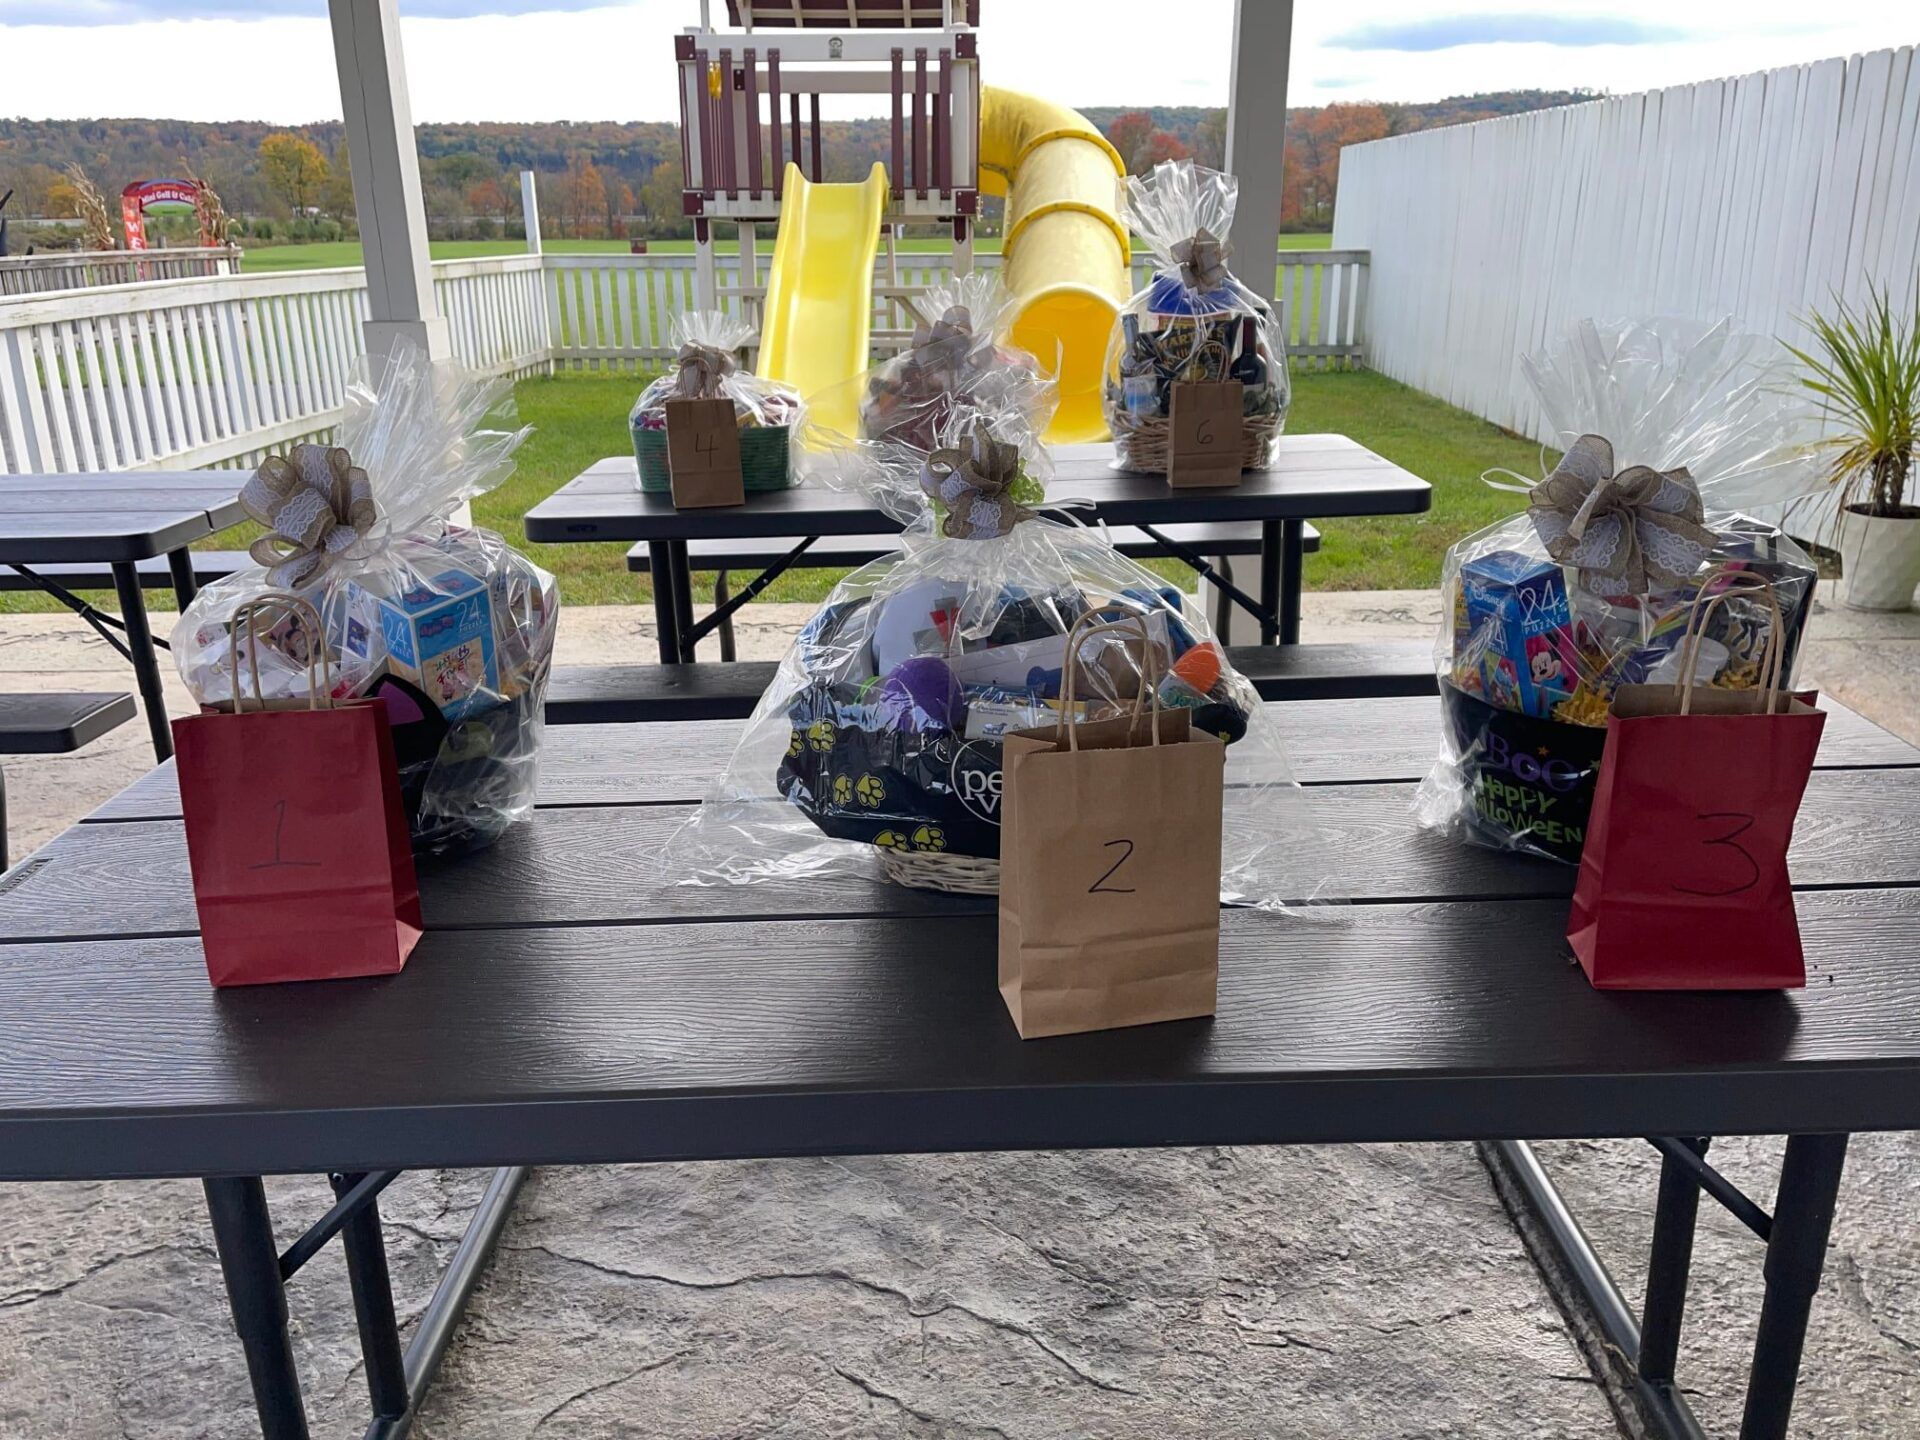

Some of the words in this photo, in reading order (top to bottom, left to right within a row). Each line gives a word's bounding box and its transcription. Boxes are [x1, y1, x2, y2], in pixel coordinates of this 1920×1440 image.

[695, 432, 719, 468] 4
[1196, 418, 1214, 444] 6
[1520, 579, 1561, 627] 24
[1524, 618, 1563, 635] PUZZLE
[961, 770, 1003, 800] pe
[247, 799, 322, 870] 1
[1672, 813, 1760, 896] 3
[1088, 839, 1136, 893] 2
